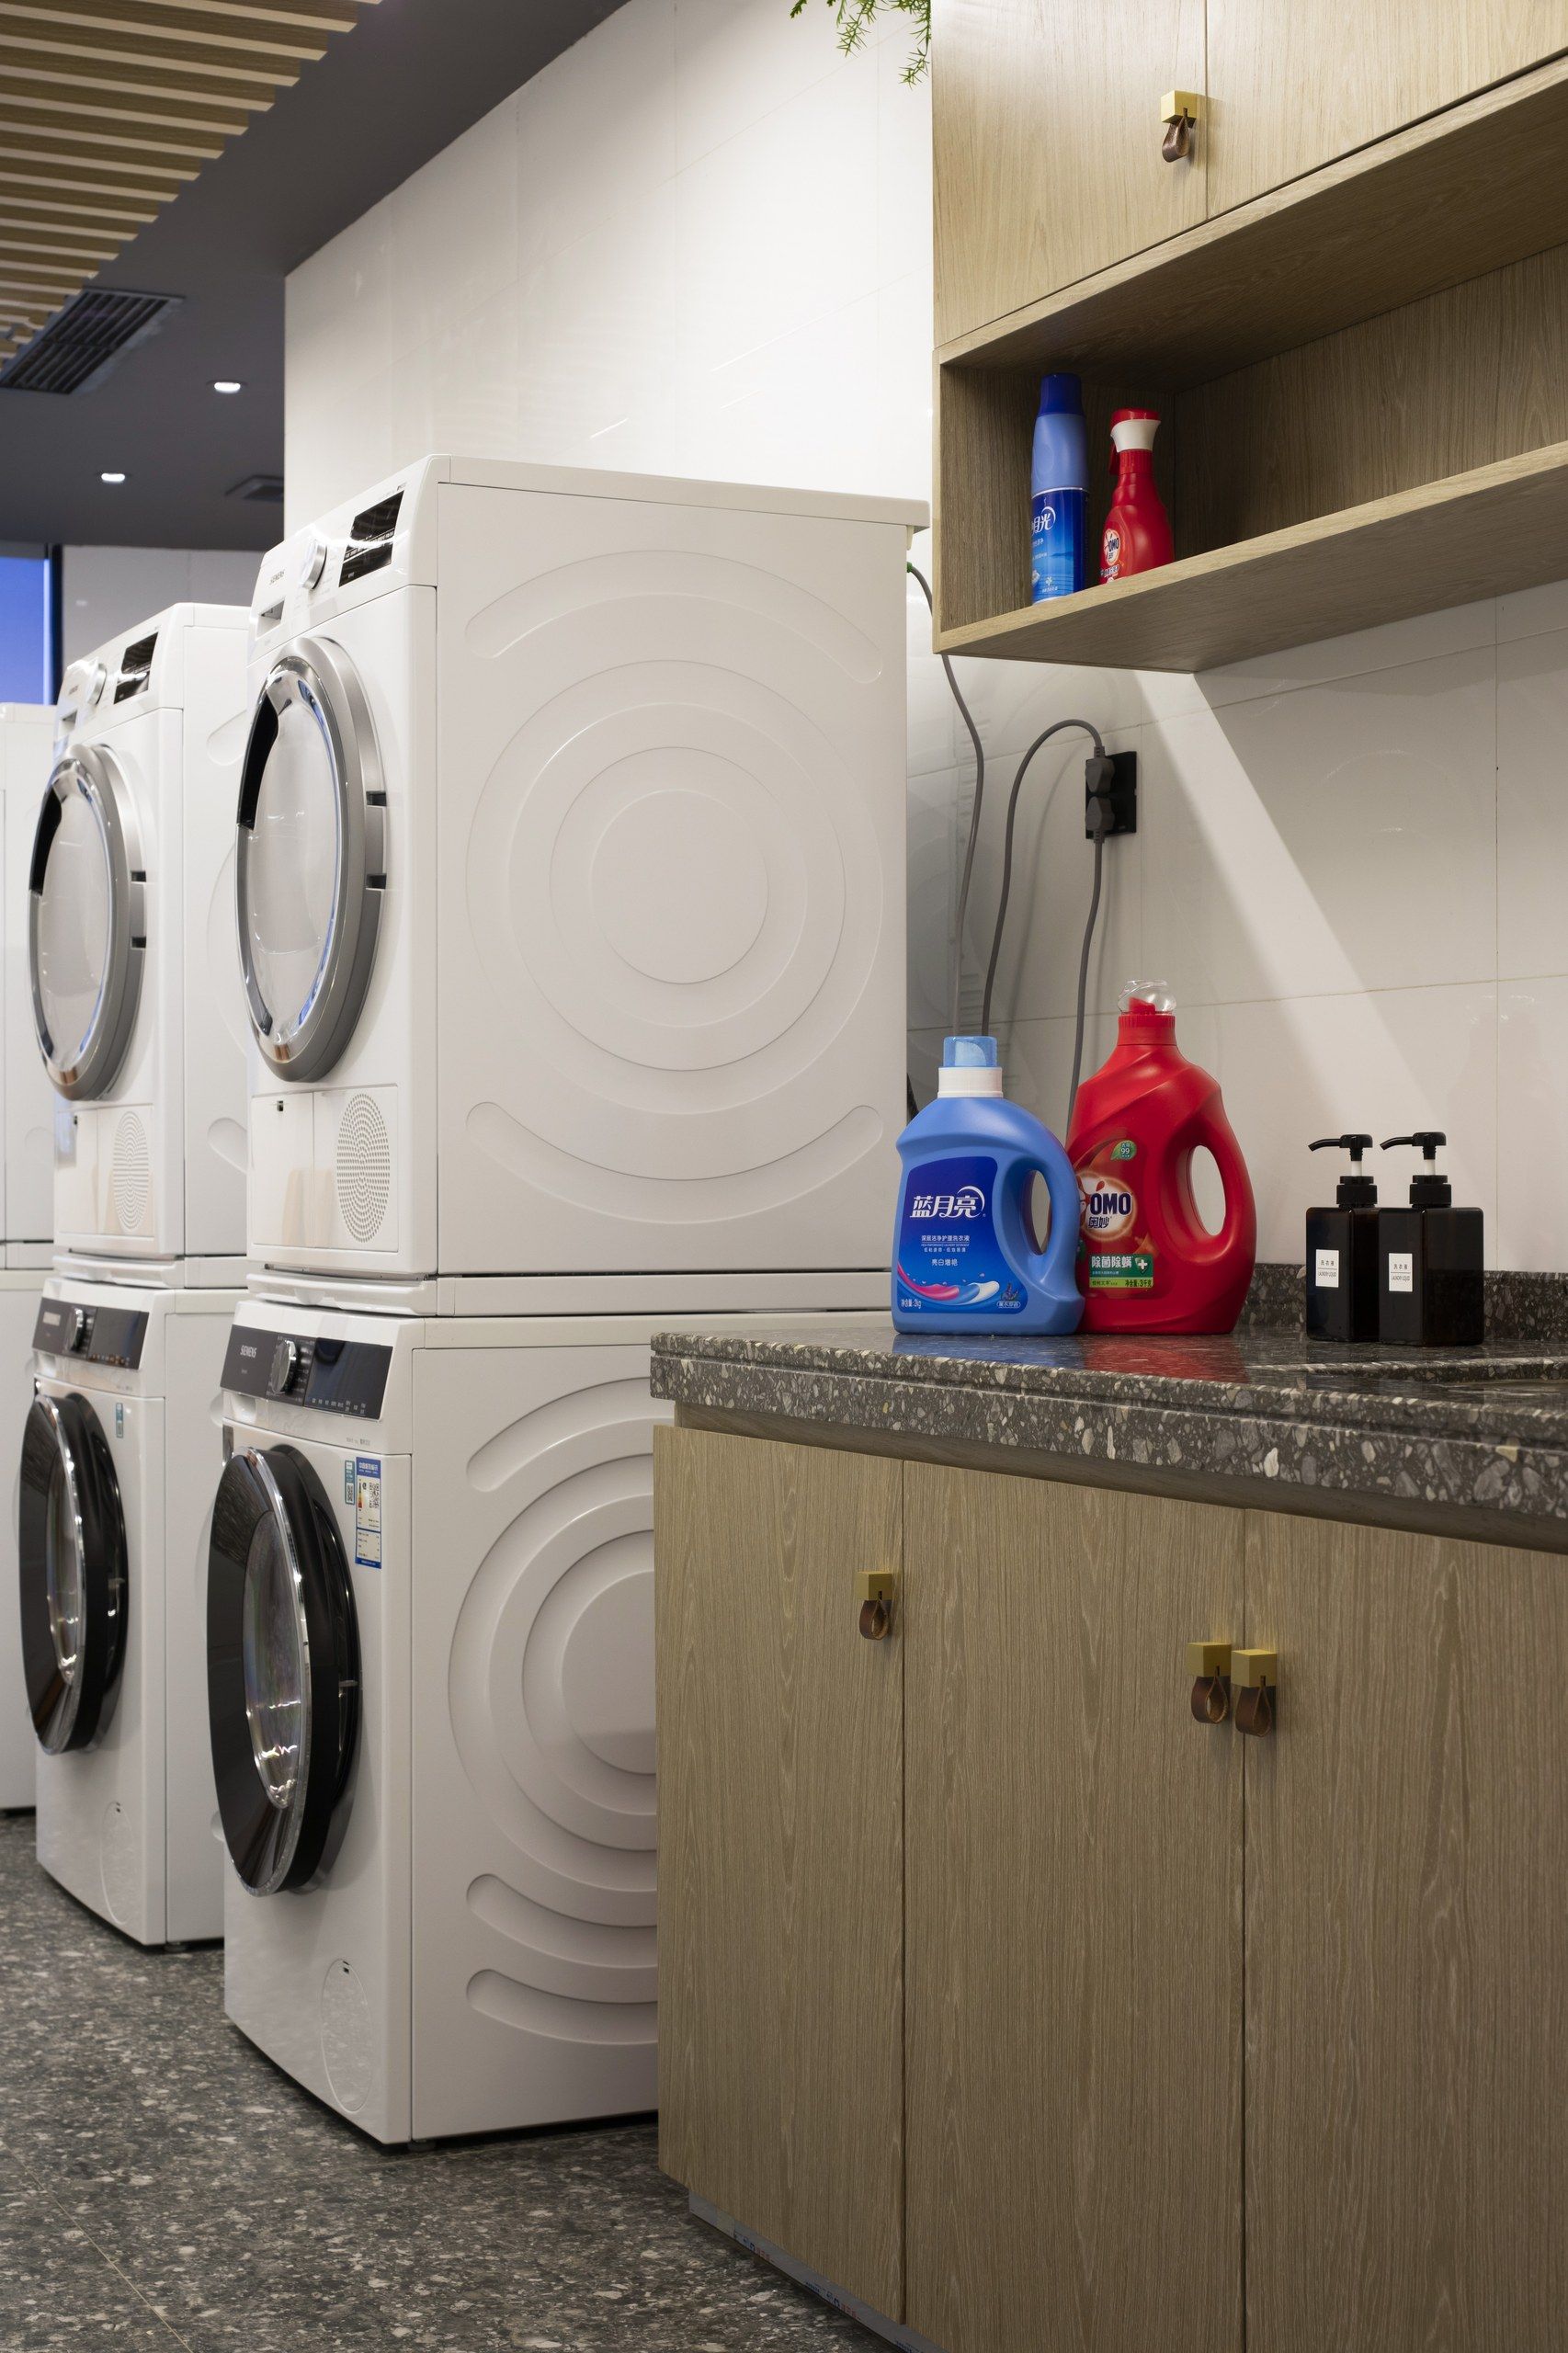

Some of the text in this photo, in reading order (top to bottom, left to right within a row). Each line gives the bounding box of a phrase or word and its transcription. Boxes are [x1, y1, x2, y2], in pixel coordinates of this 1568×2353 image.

[910, 1188, 984, 1218] 蓝月亮
[1089, 1192, 1131, 1215] OMO
[1088, 1216, 1110, 1228] 奥妙
[1091, 1256, 1132, 1268] 除菌除螨
